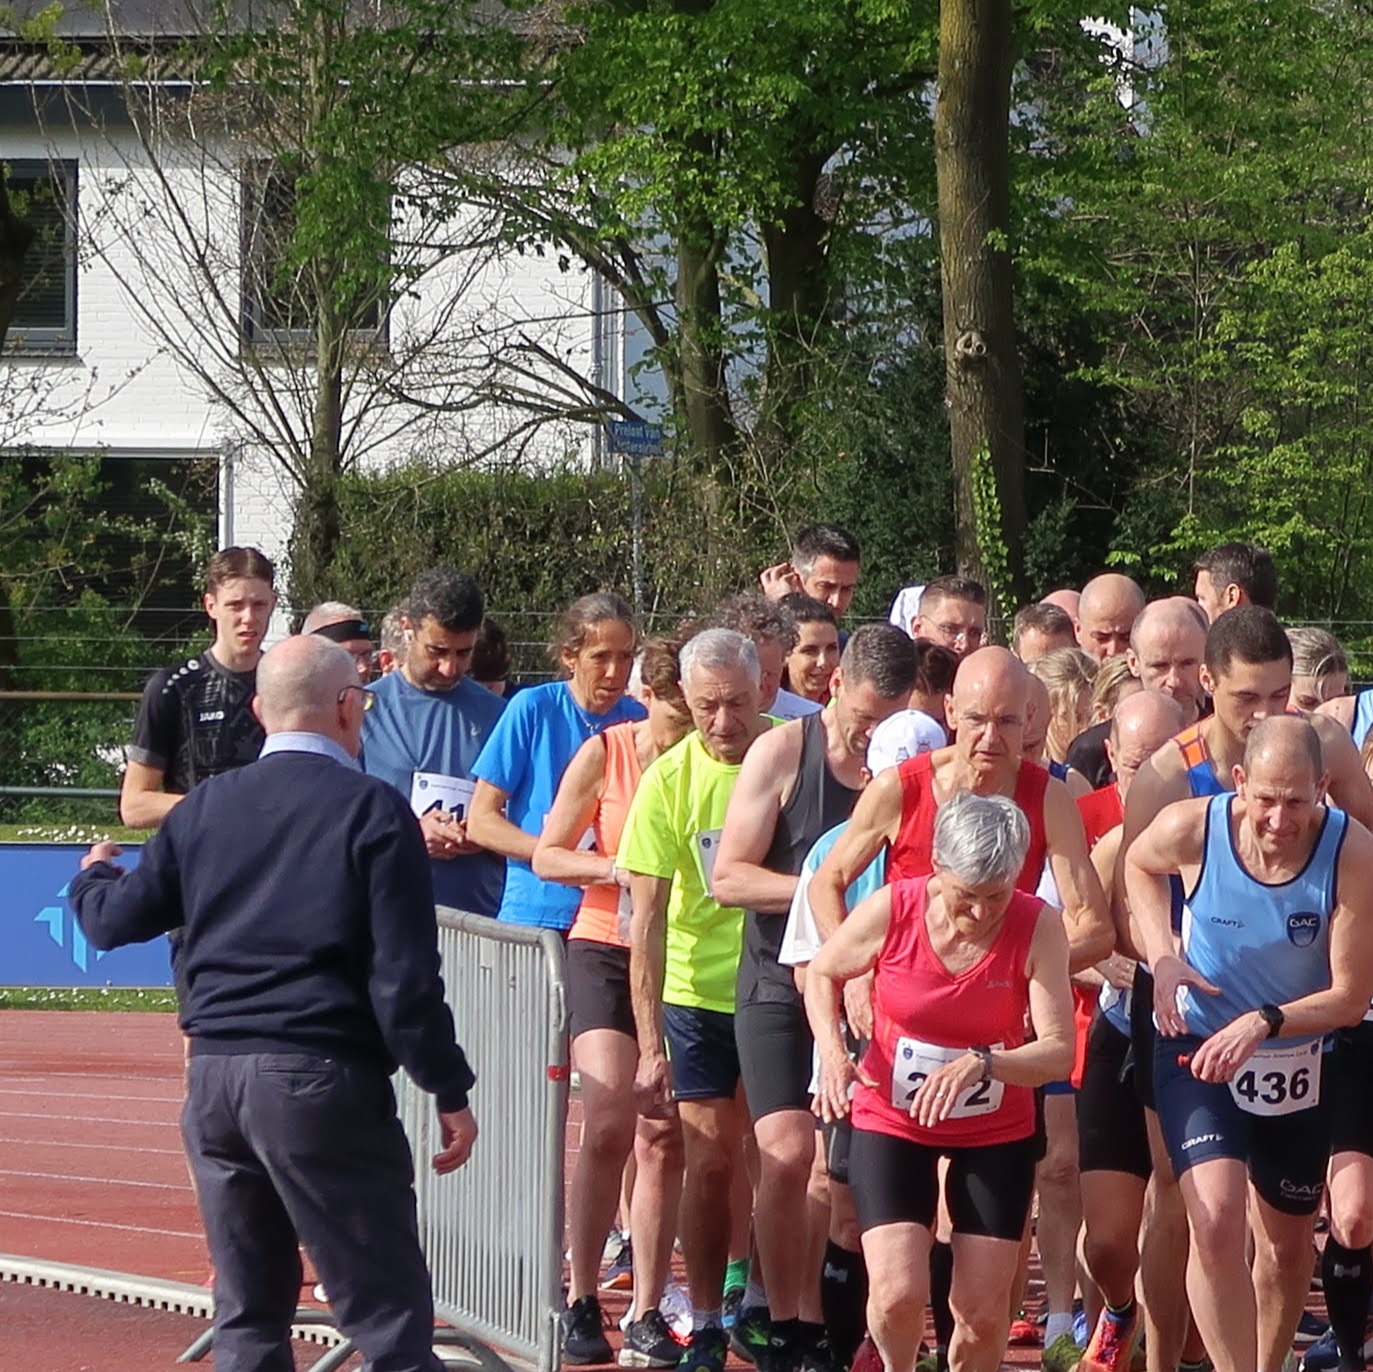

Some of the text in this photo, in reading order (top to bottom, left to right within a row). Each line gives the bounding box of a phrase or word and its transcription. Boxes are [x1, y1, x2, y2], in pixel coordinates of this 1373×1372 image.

[905, 1071, 991, 1107] 22
[1235, 1067, 1310, 1105] 436
[1181, 1133, 1215, 1150] CRAFT
[1279, 1178, 1324, 1195] GAC
